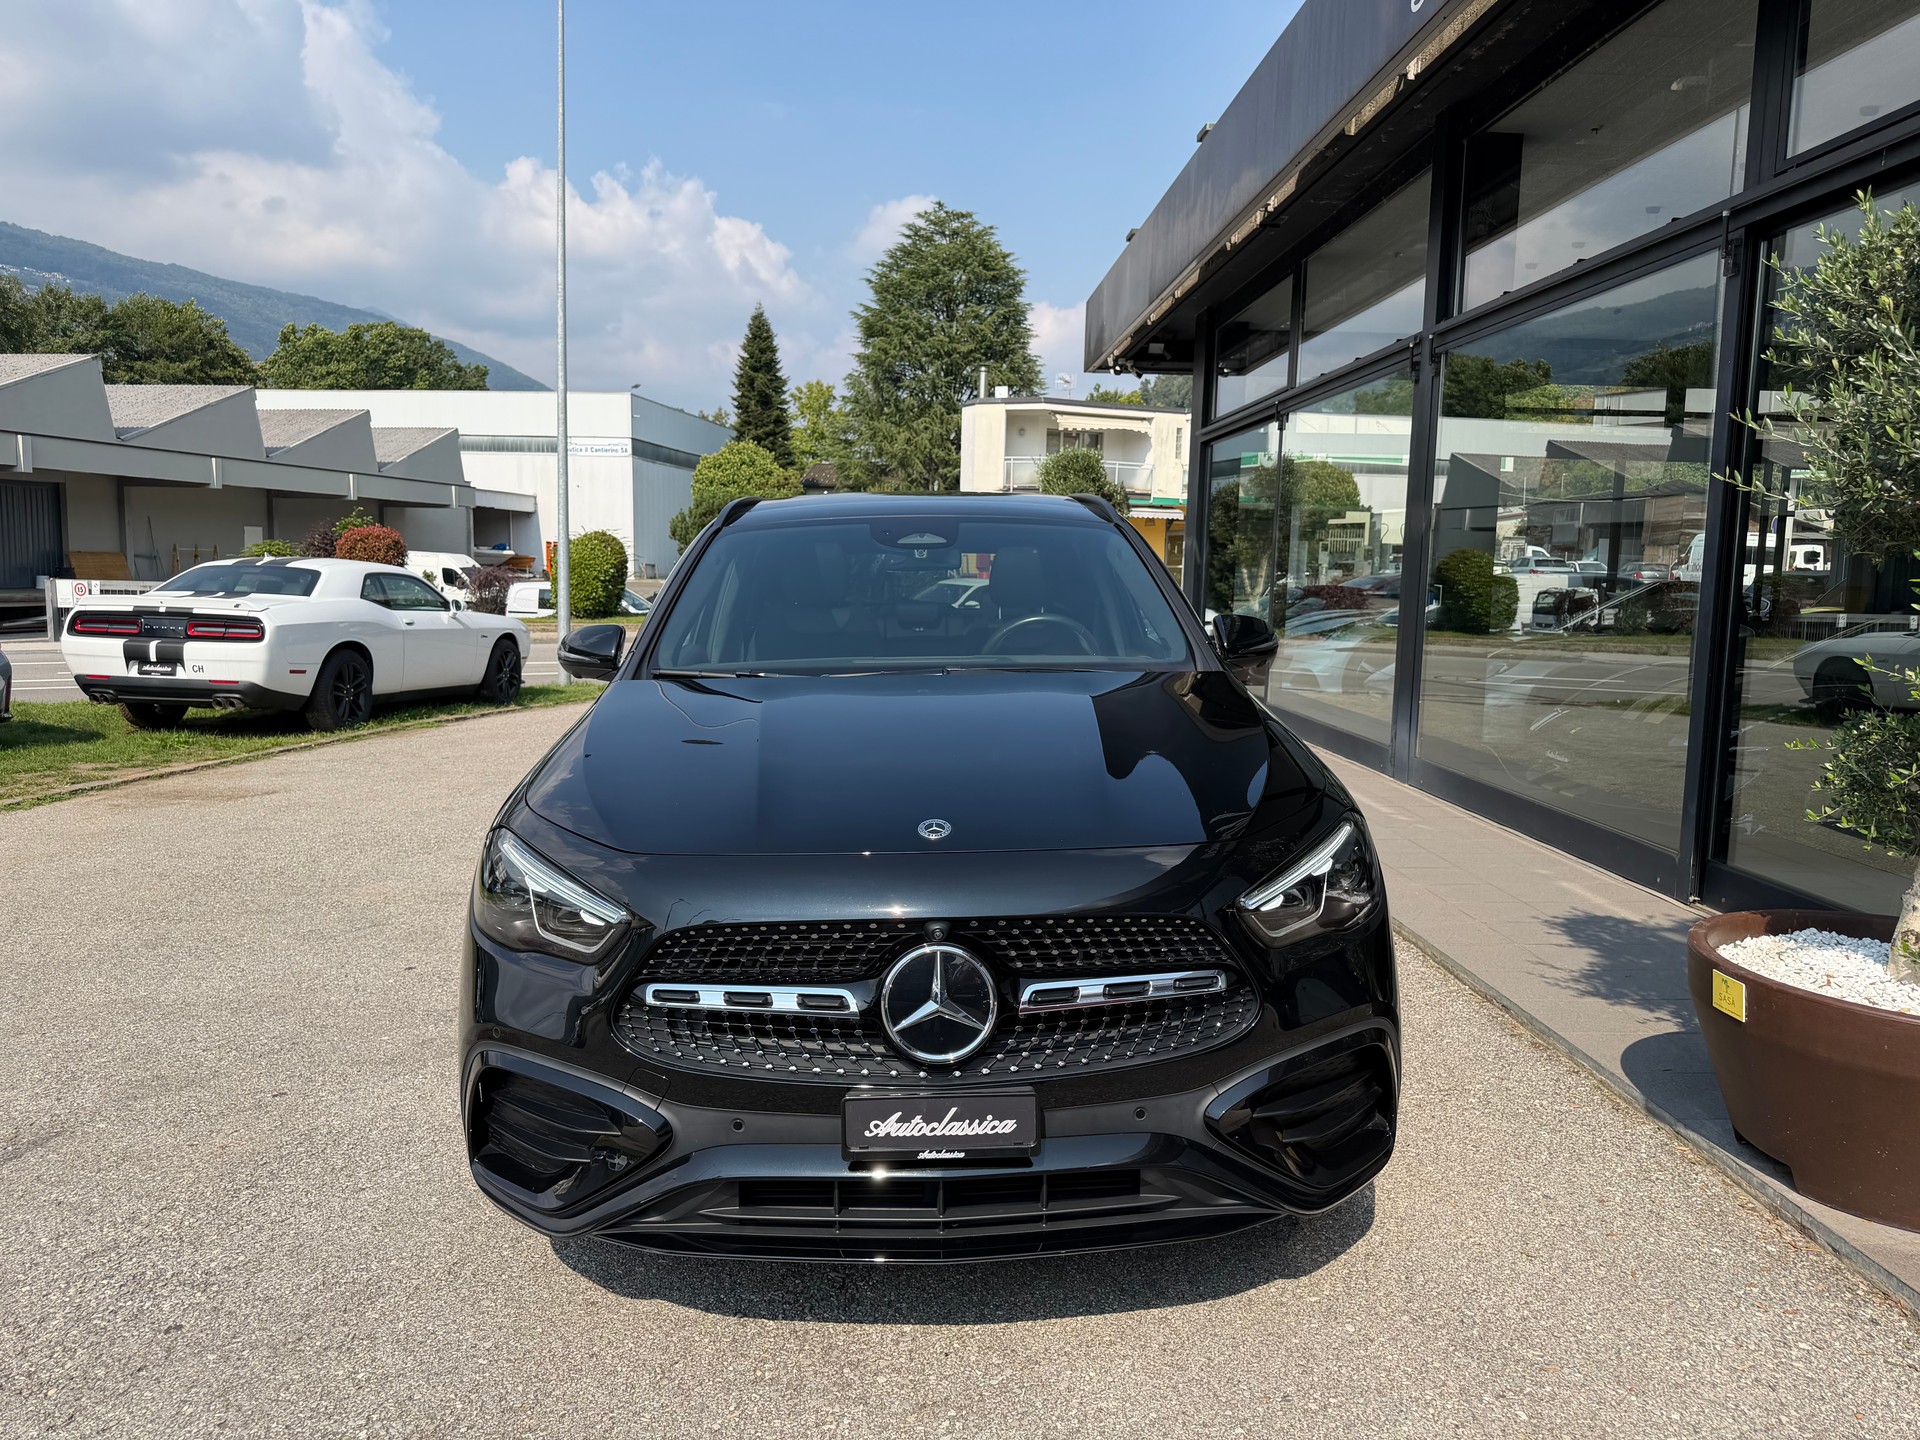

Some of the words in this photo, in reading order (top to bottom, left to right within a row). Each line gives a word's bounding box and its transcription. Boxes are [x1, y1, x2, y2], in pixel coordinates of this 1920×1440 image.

[590, 446, 619, 454] Cantierino
[191, 664, 205, 673] CH
[1718, 992, 1736, 1008] SASA
[864, 1106, 1018, 1138] Autoclassica
[917, 1149, 966, 1160] Autoclassica
